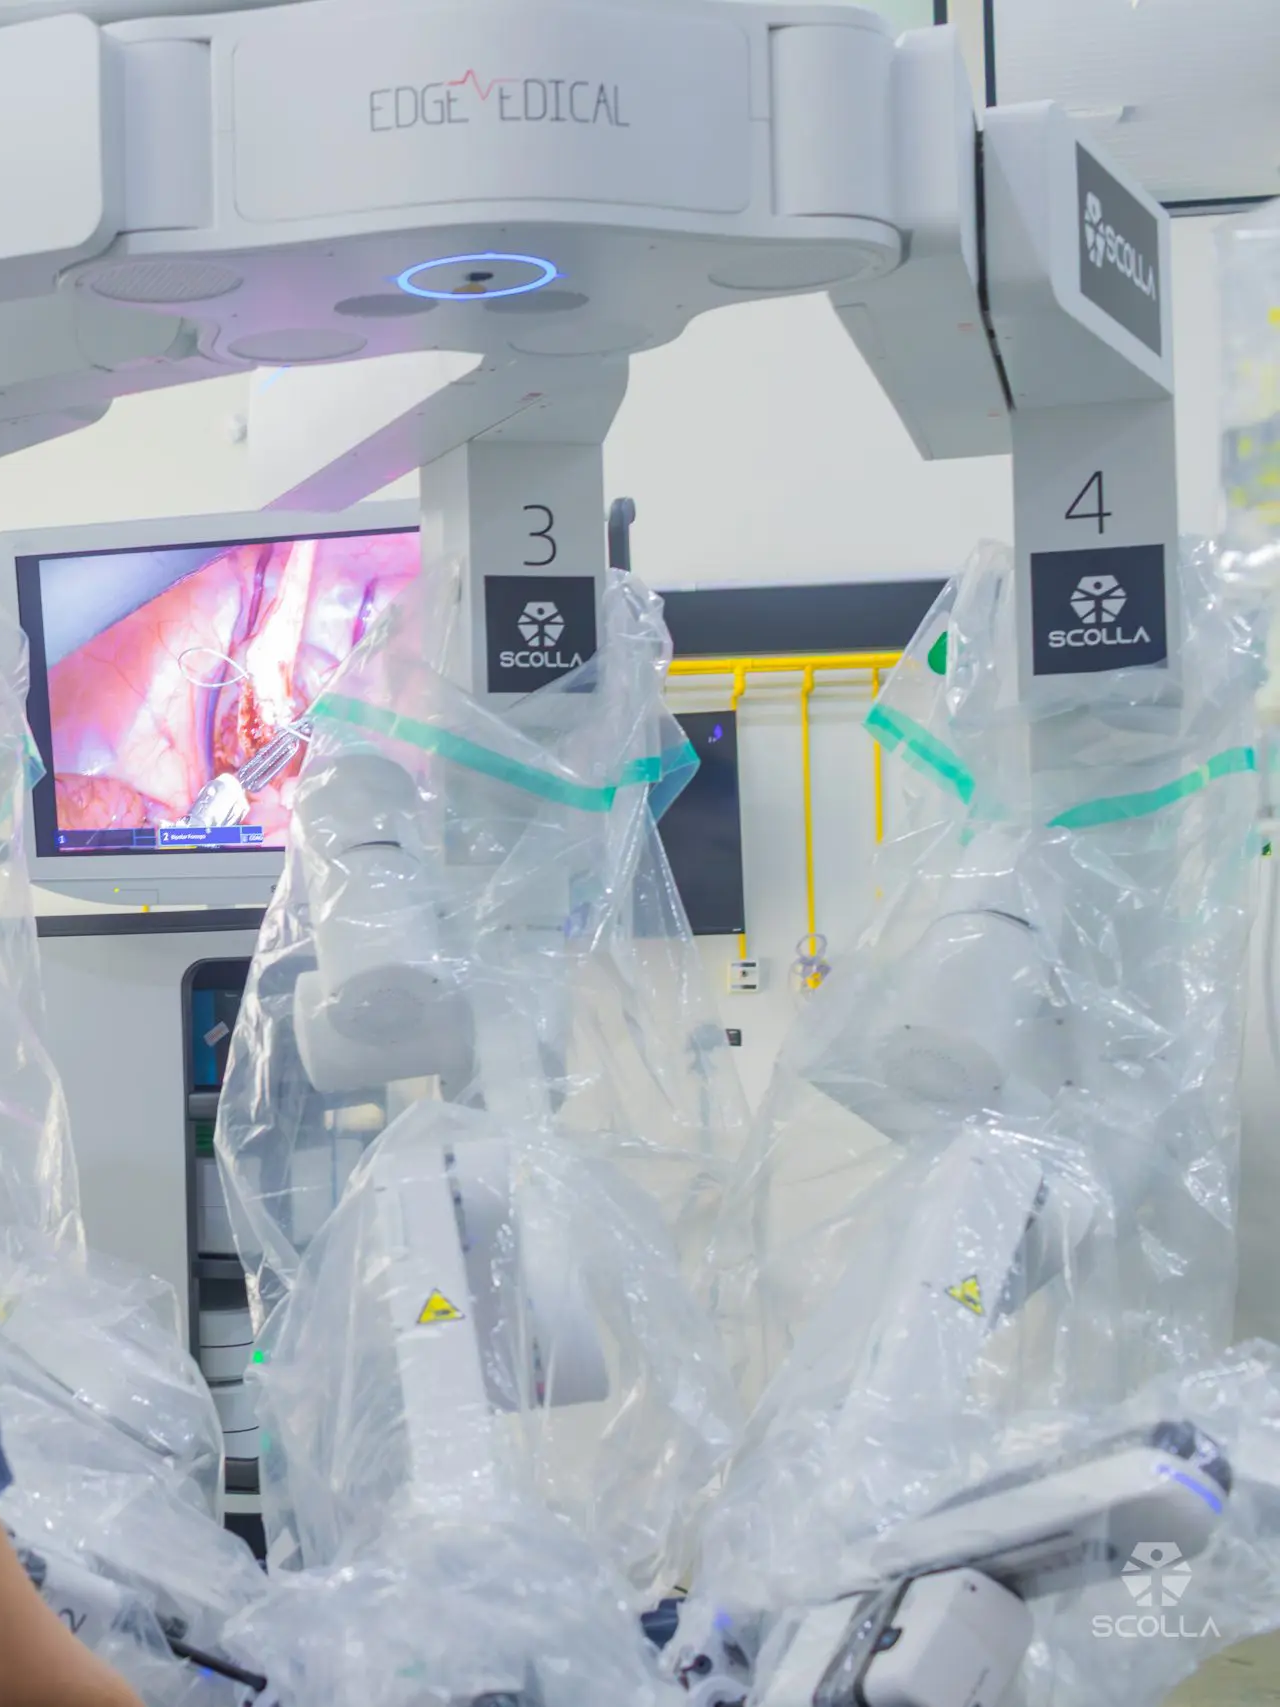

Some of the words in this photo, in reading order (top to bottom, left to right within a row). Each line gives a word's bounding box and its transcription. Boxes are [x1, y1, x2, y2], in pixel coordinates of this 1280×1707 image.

[1105, 224, 1156, 301] SCOLLA
[1064, 470, 1112, 534] 4
[523, 504, 557, 566] 3
[1048, 625, 1152, 648] SCOLLA
[499, 651, 584, 668] SCOLLA
[163, 832, 169, 841] 2
